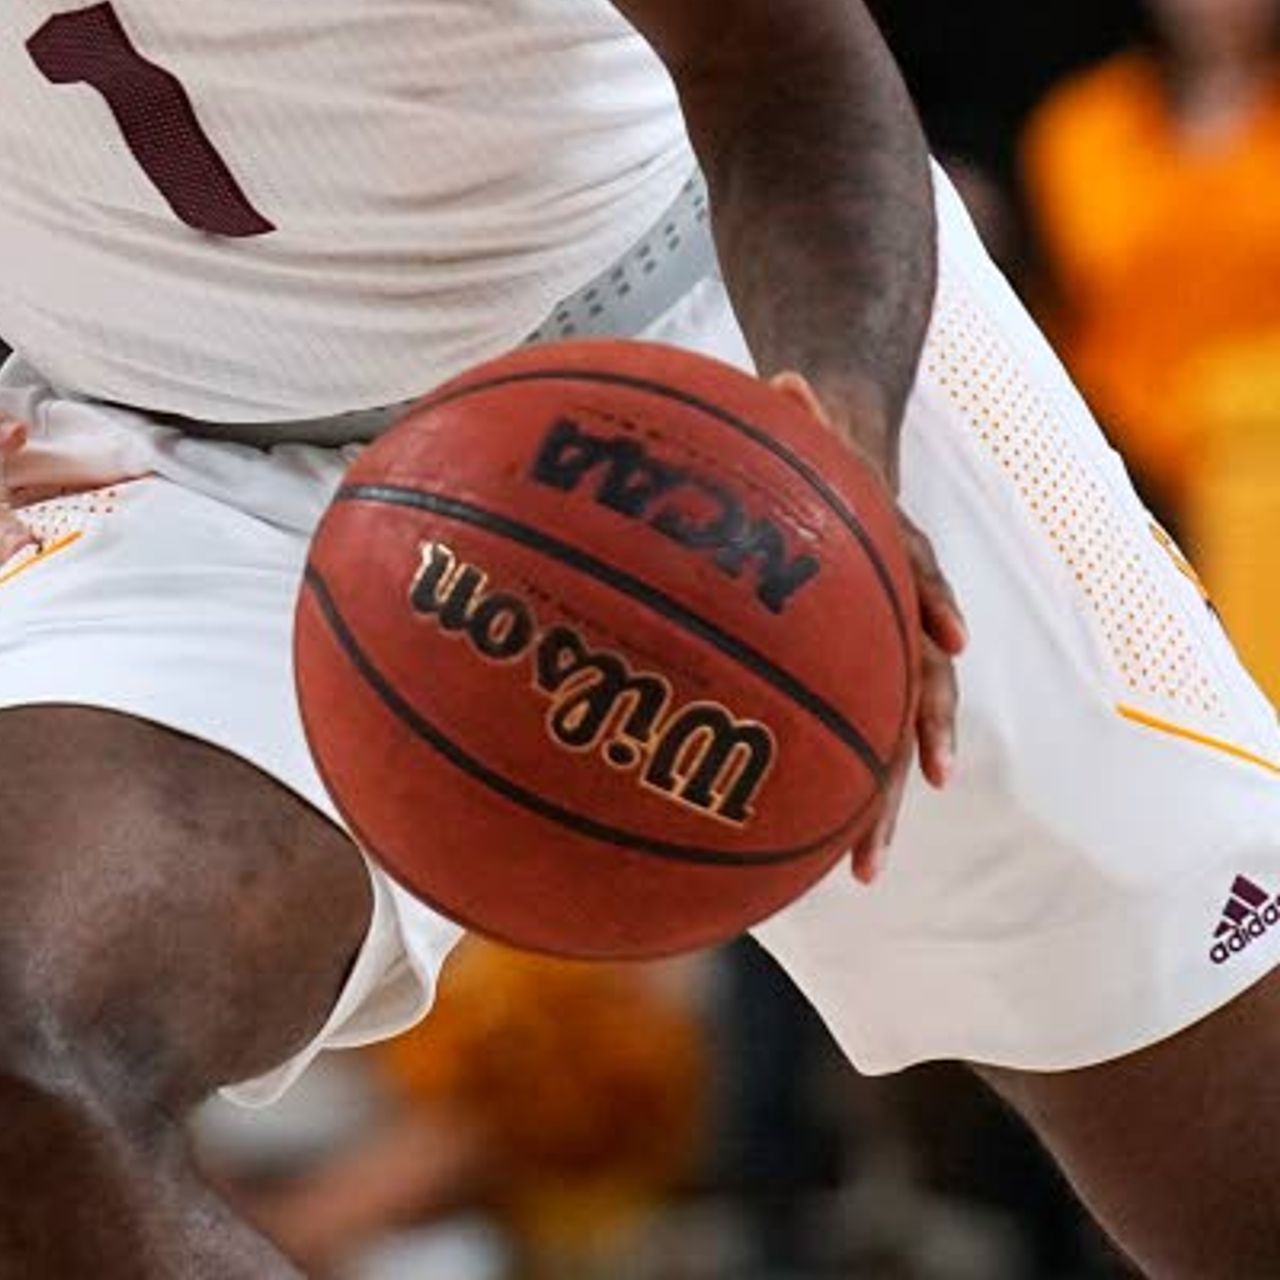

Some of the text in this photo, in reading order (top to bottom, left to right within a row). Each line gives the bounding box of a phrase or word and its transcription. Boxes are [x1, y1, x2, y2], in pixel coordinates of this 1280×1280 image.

[24, 0, 278, 239] 1
[529, 416, 822, 616] NCAA
[408, 540, 777, 828] Wilson
[1209, 894, 1280, 964] adida
